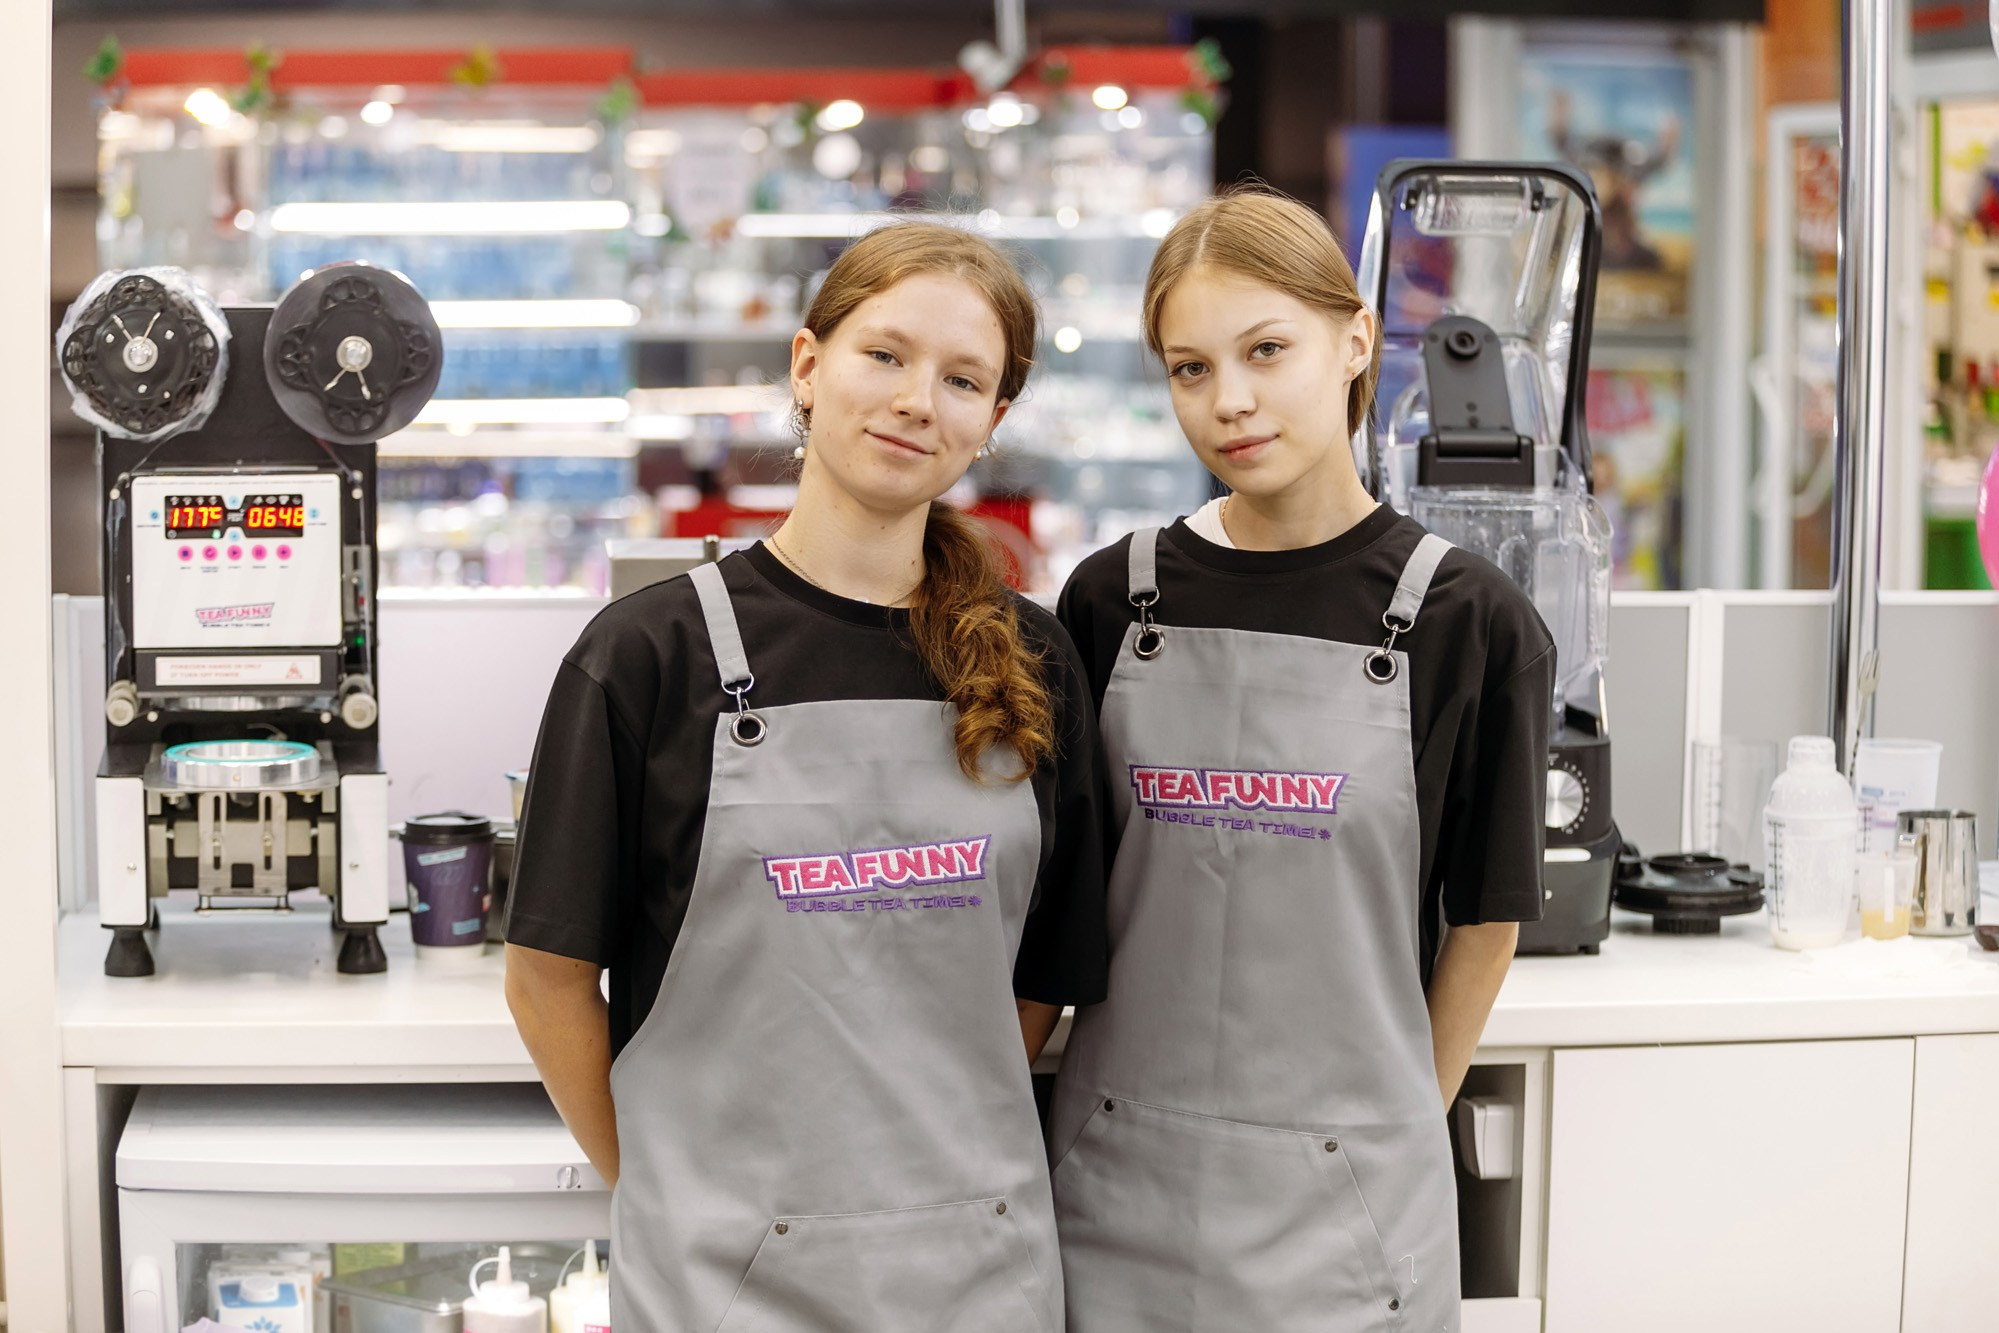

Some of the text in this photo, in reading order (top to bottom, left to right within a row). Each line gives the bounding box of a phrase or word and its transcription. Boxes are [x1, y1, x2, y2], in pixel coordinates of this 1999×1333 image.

[198, 609, 224, 621] TEA
[1134, 767, 1344, 810] TEA FUNNY
[1145, 808, 1317, 839] BUBBLE TEA TIME!
[767, 838, 987, 895] TEA FUNNY
[786, 895, 966, 913] BUBBLE TEA TIME!
